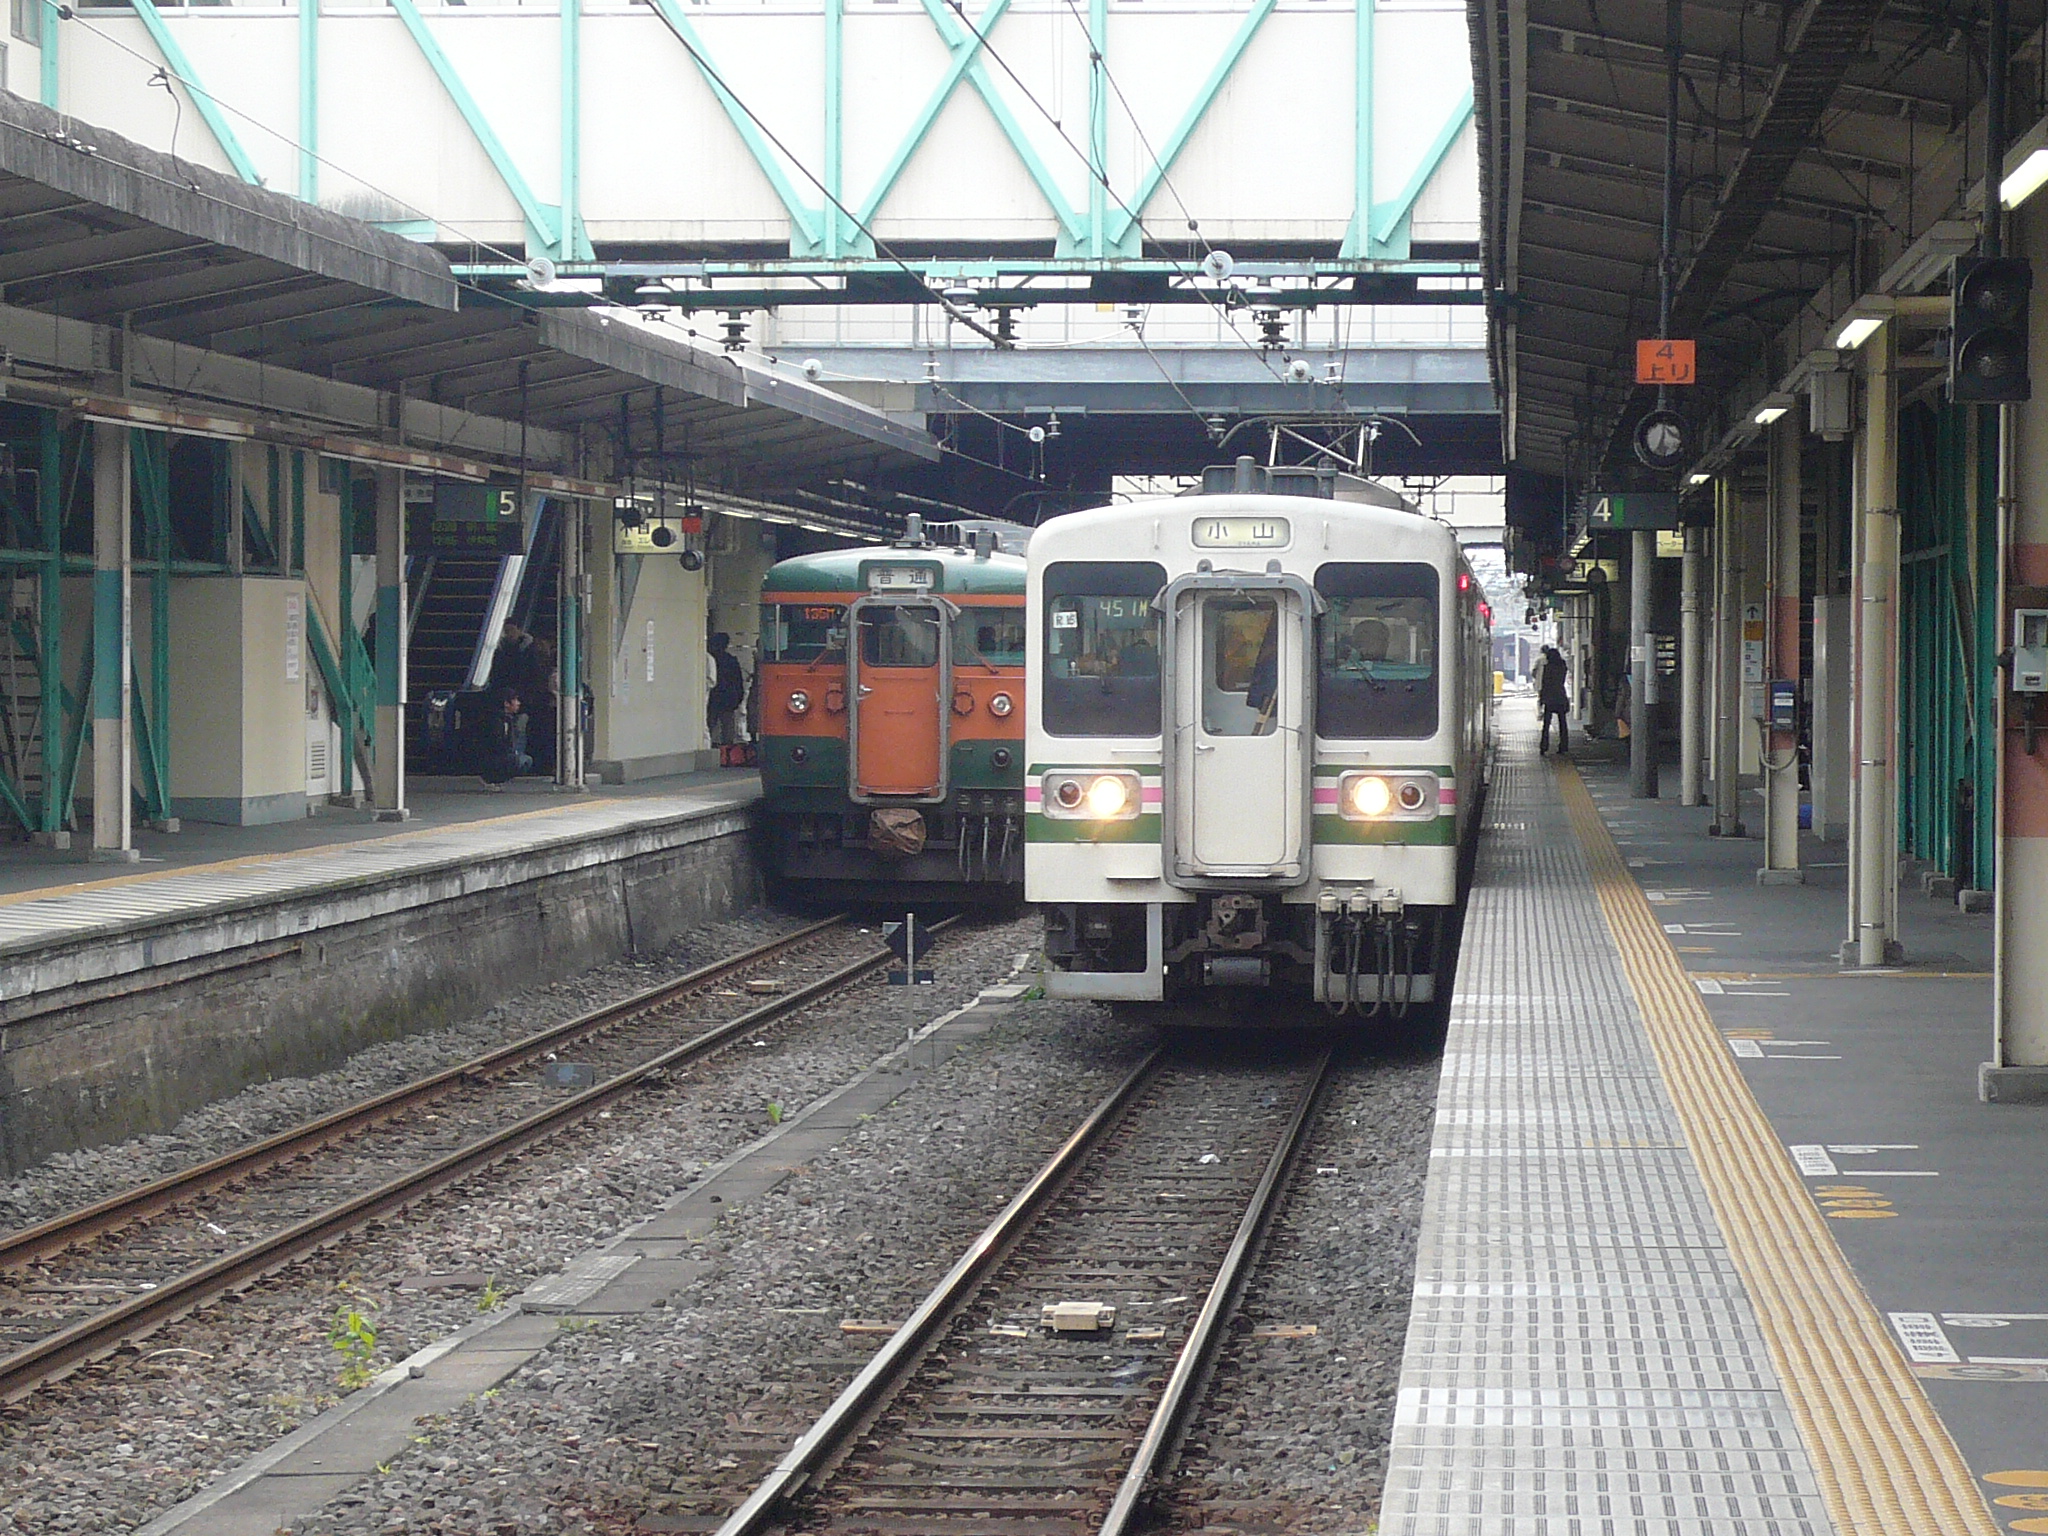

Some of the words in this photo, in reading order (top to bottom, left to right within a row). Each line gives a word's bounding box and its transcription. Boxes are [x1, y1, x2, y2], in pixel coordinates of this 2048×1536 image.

[1656, 342, 1675, 360] 4
[1643, 363, 1689, 381] 上り
[500, 490, 515, 515] 5
[1592, 497, 1611, 521] 4
[1208, 521, 1274, 539] 小山
[877, 567, 928, 585] 普通
[1100, 599, 1148, 617] 451M
